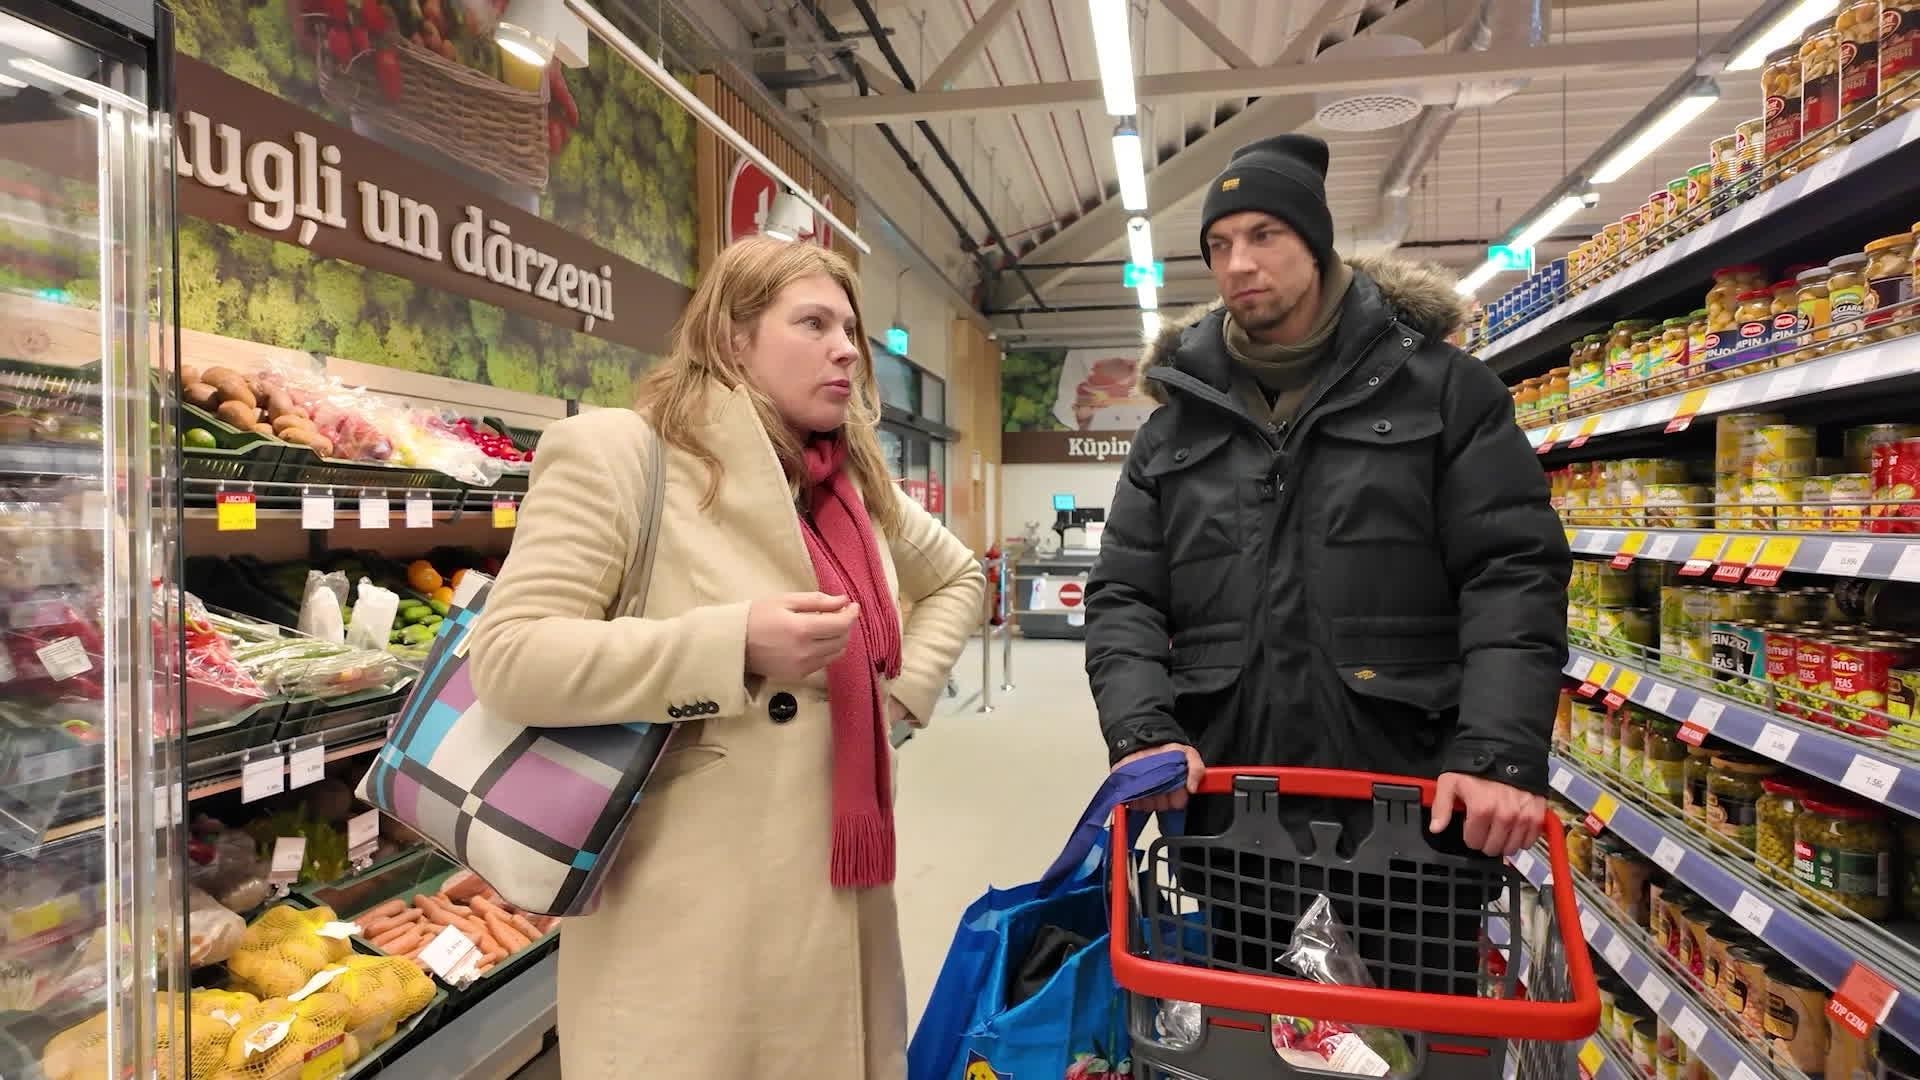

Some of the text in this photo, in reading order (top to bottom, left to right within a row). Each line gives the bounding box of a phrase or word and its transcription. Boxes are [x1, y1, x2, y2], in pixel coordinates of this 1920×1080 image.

[176, 111, 614, 333] ugļi un dārzeņi
[1830, 999, 1868, 1034] TOP CENA
